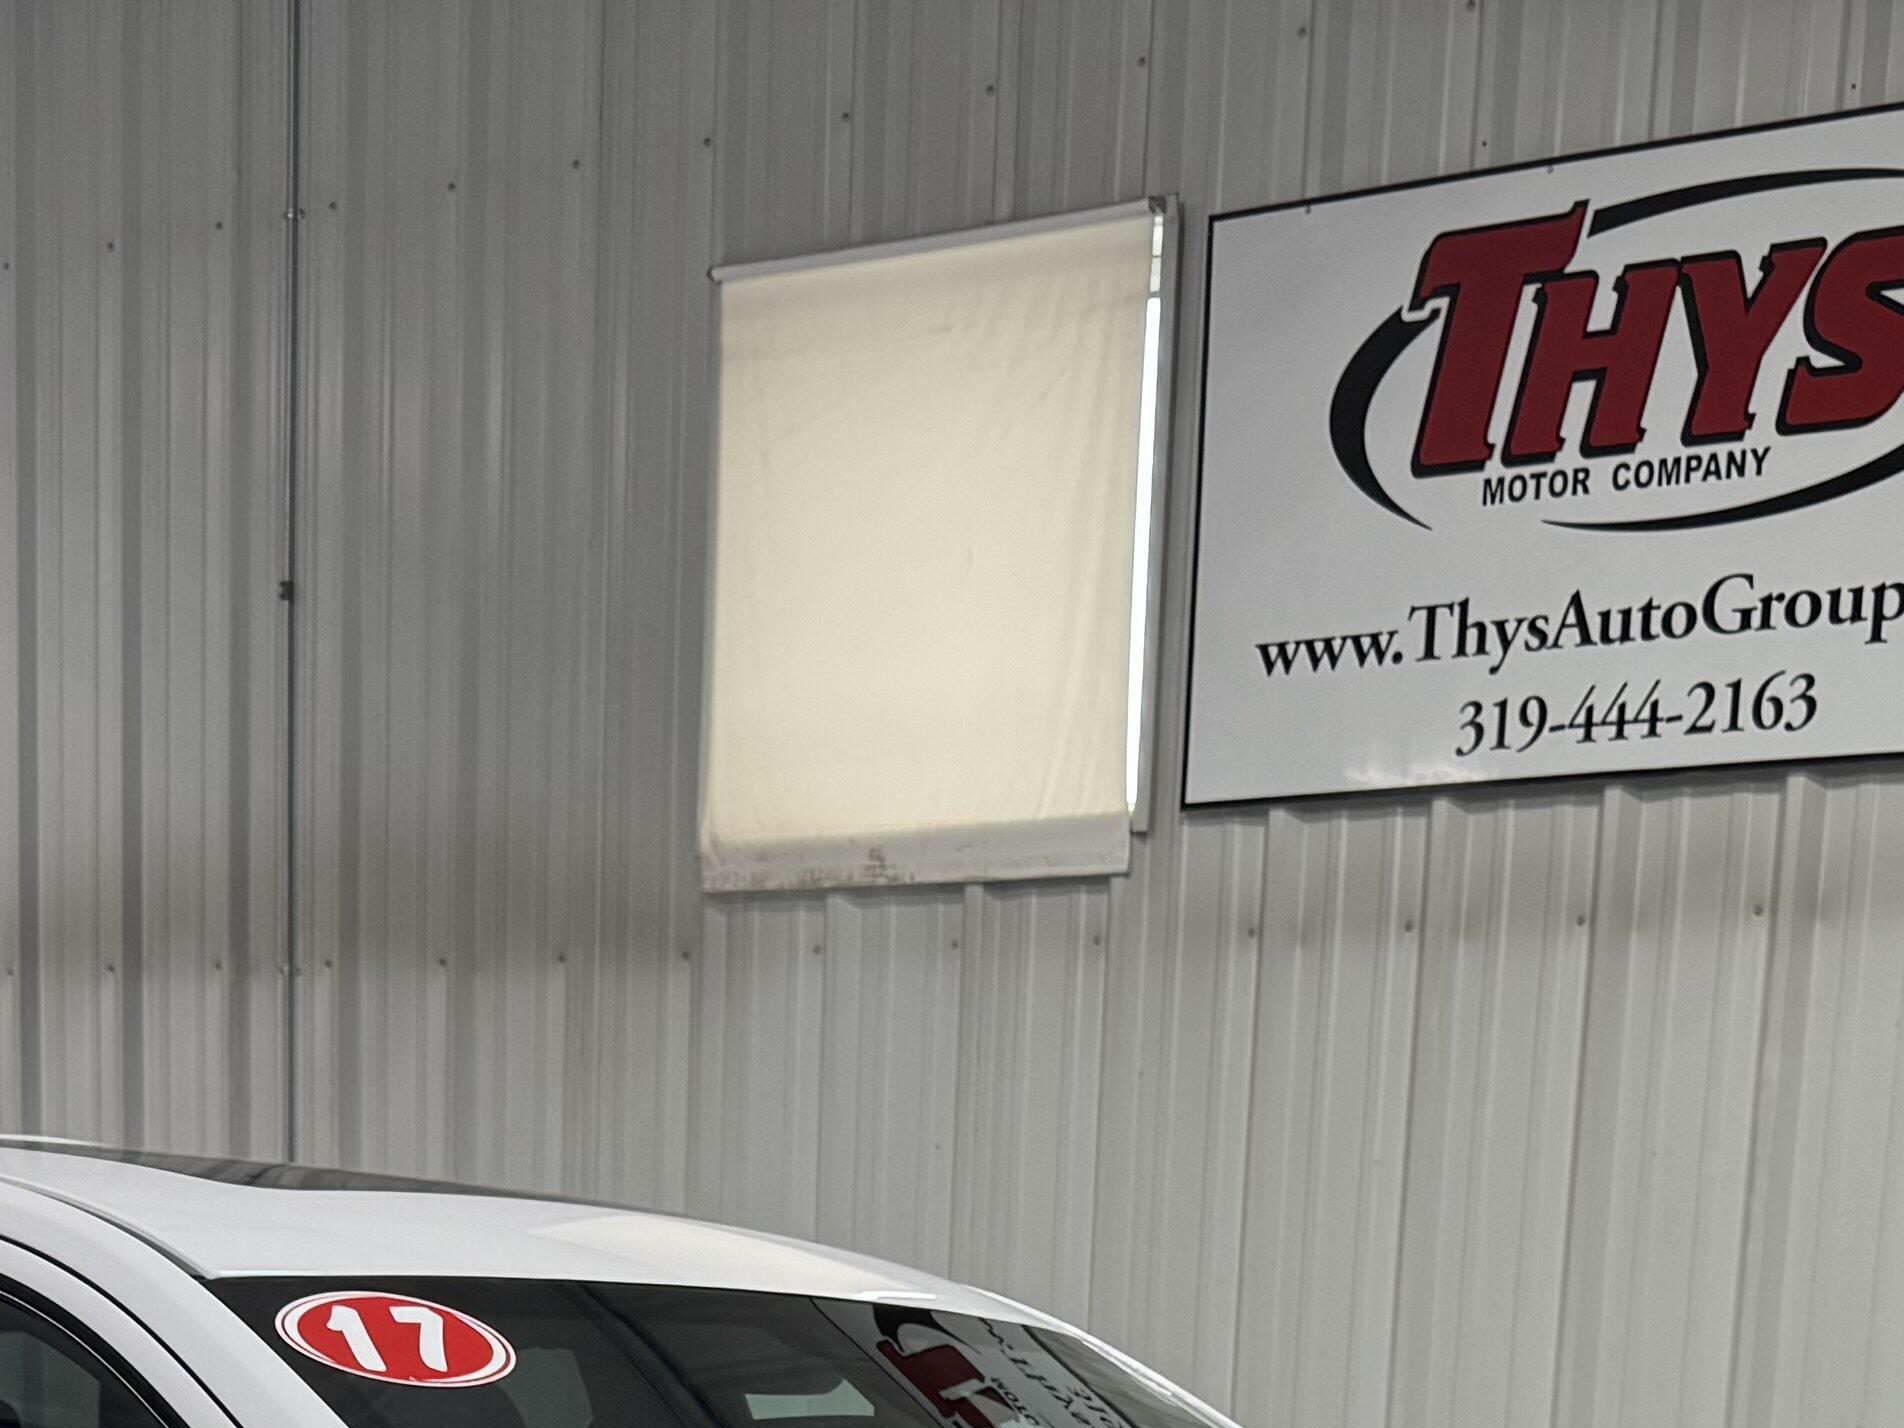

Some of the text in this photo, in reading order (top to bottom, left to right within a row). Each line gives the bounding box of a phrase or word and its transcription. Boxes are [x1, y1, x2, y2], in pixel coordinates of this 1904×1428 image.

[1481, 446, 1772, 507] MOTOR COMPANY
[1455, 669, 1818, 757] 319-444-2163
[325, 1304, 449, 1373] 17
